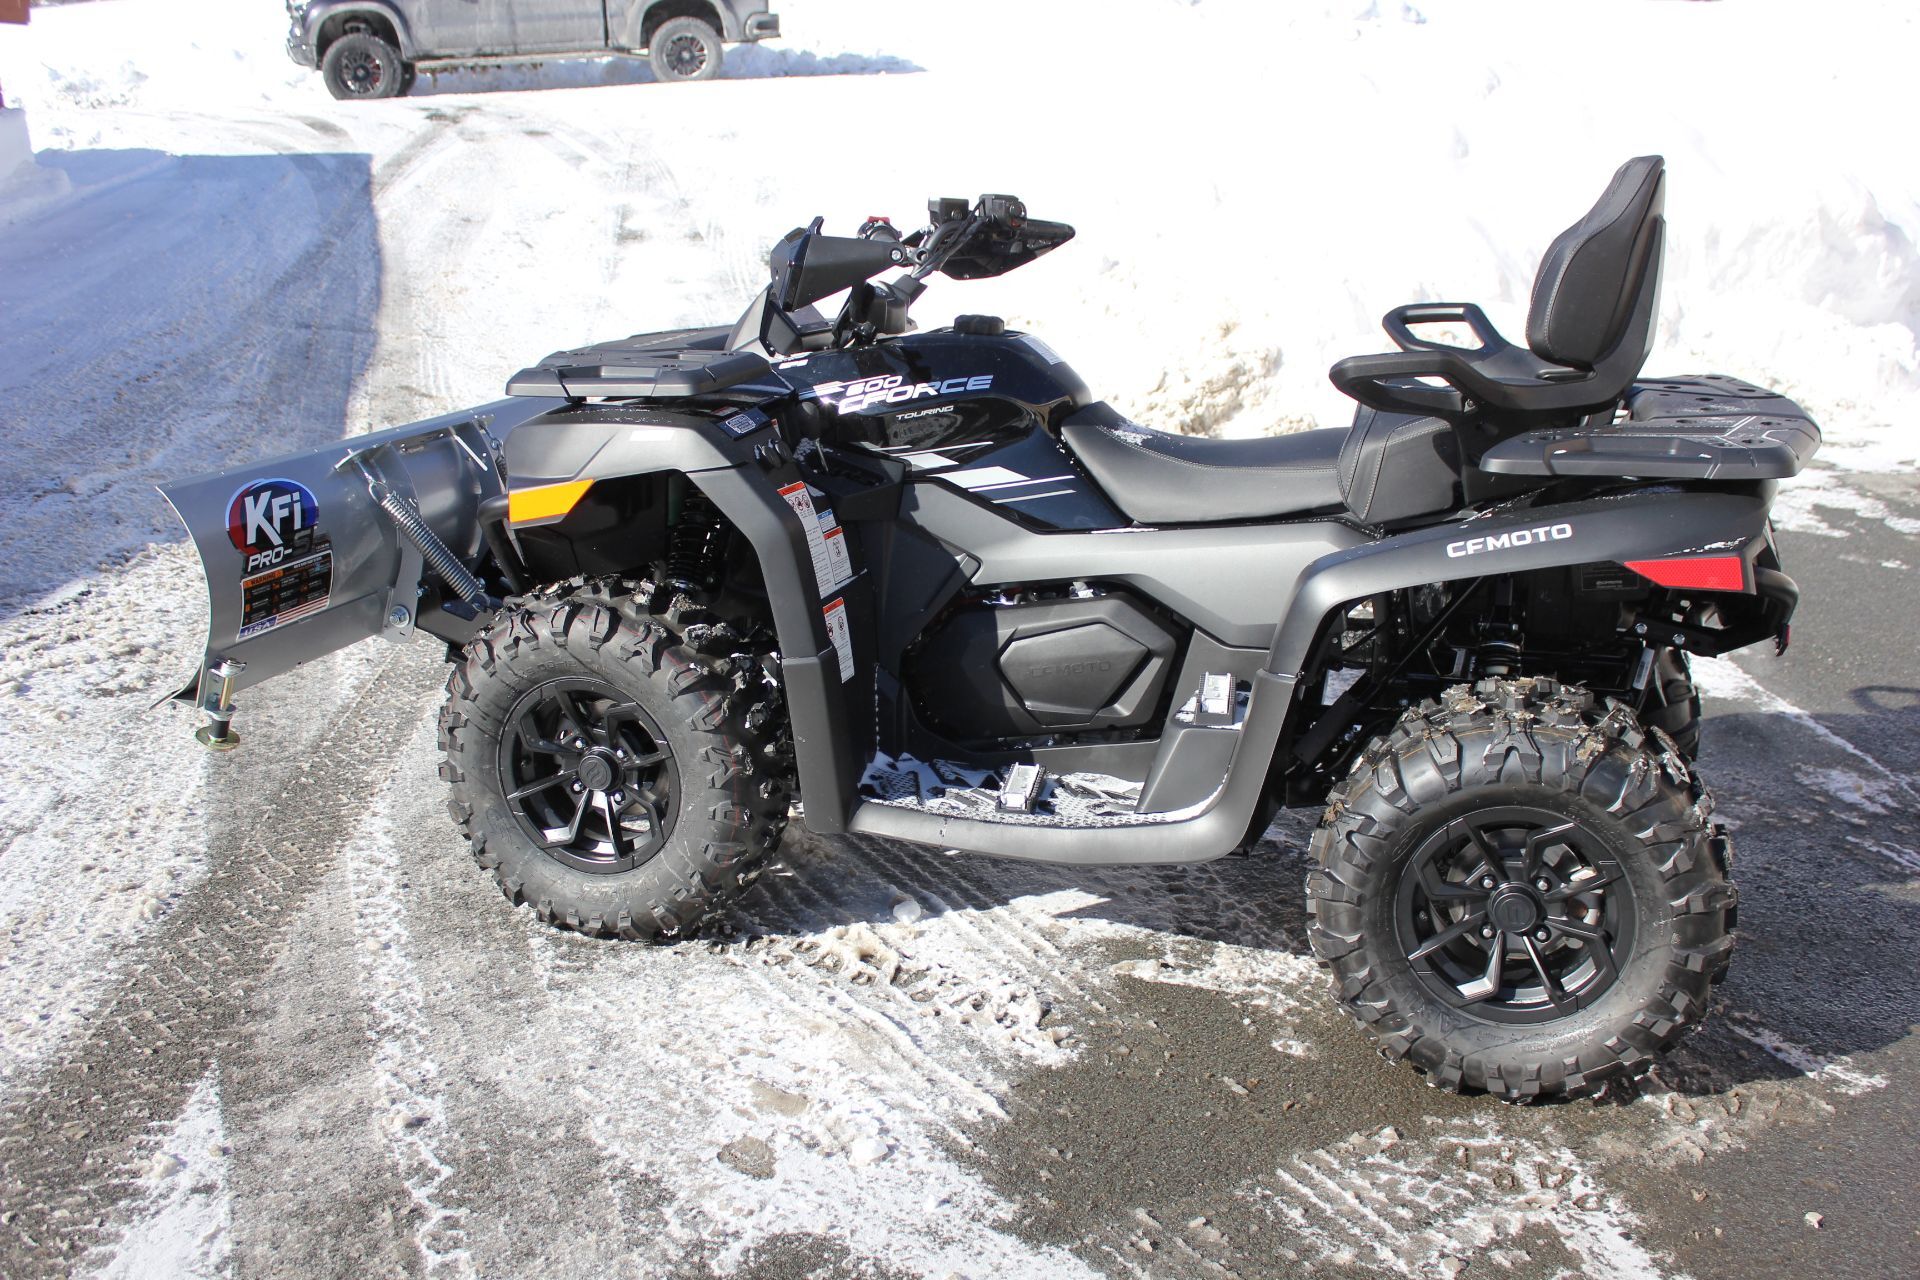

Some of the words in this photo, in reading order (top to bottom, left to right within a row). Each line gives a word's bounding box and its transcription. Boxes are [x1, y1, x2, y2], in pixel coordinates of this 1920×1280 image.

[837, 374, 994, 415] CFORCE
[895, 405, 955, 420] TOURING
[1446, 523, 1573, 558] CFMOTO
[244, 621, 271, 636] USA
